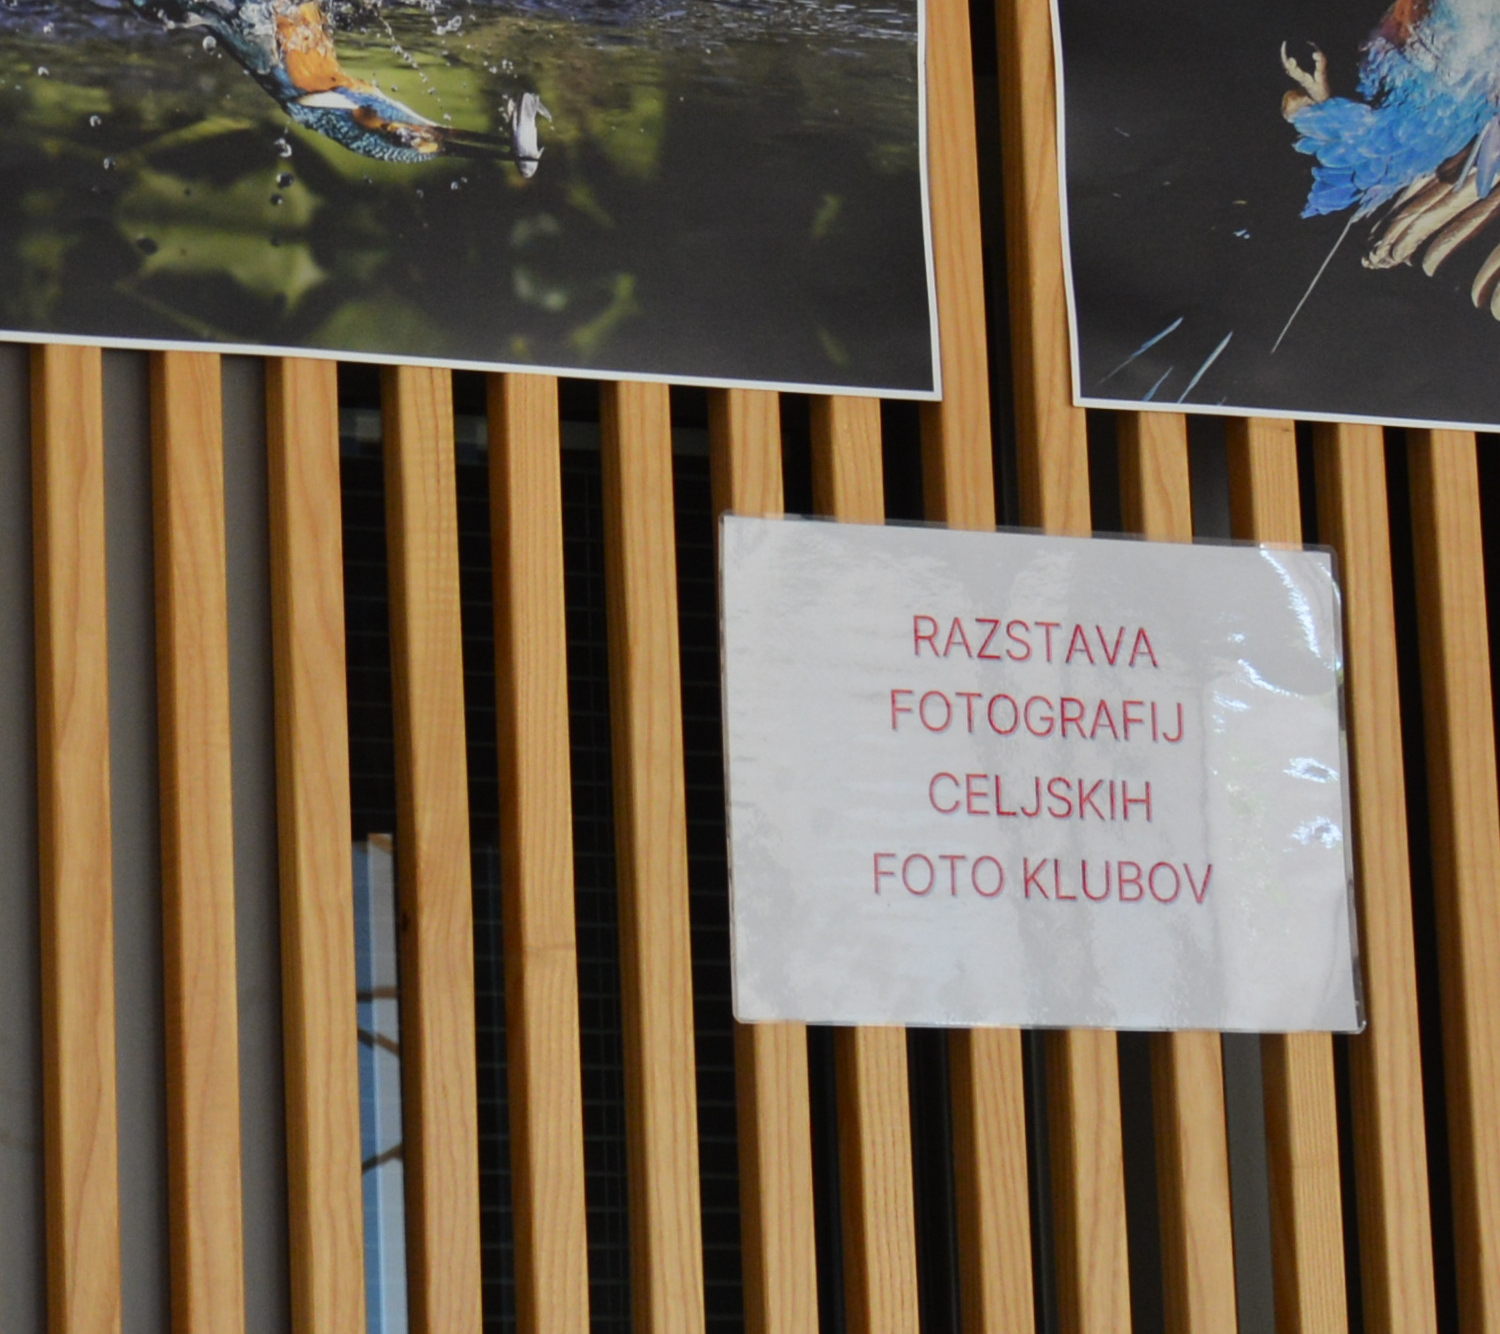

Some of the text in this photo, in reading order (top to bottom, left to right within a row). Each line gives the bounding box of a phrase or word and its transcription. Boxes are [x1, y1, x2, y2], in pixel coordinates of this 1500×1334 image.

[913, 614, 1159, 667] RAZSTAVA
[890, 688, 1185, 743] FOTOGRAFIJ
[929, 771, 1153, 820] CELJSKIH
[873, 852, 1213, 904] FOTO KLUBOV
